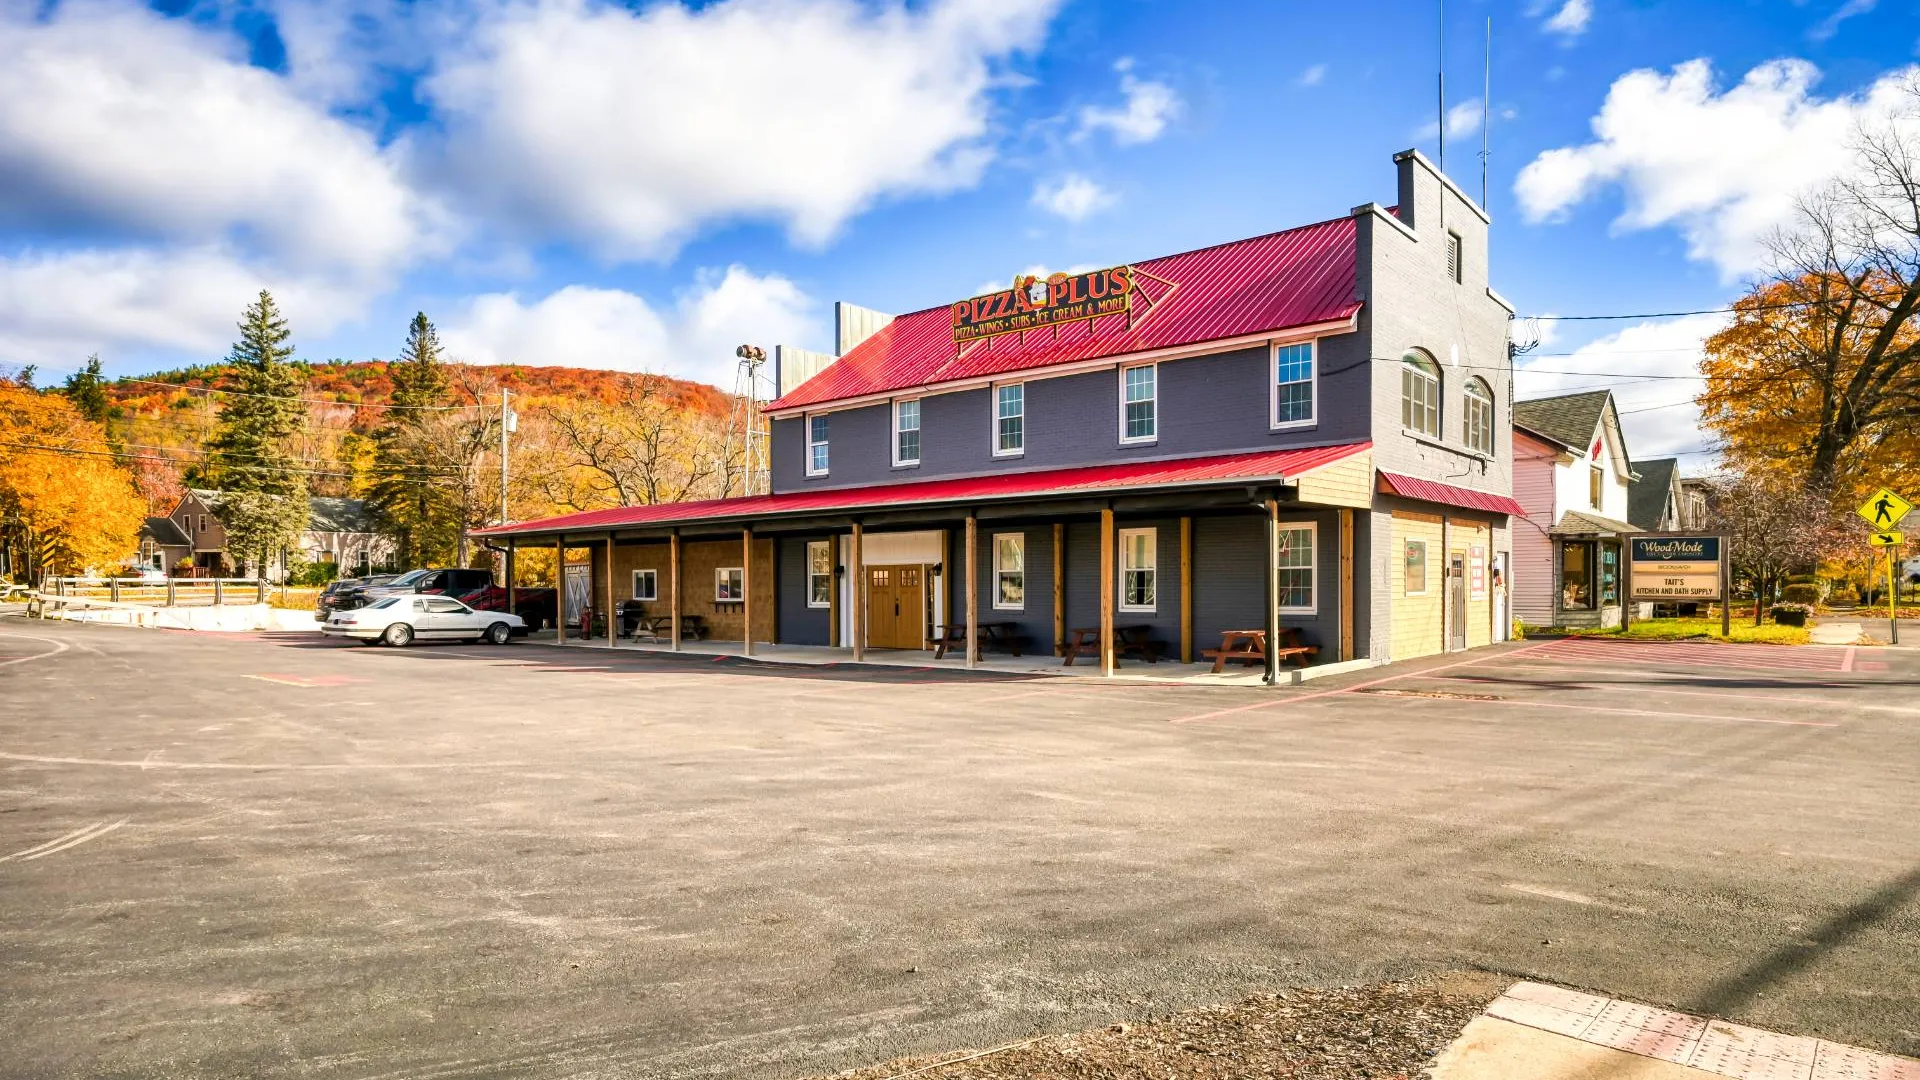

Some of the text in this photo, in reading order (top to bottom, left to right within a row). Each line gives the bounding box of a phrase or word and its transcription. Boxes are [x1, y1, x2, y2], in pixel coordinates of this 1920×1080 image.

[954, 266, 1129, 326] PIZZA PLUS
[955, 296, 1124, 339] PIZZA WINGS SUBS ICE CREAM & MORE
[1640, 541, 1703, 552] Wood-Mode
[1664, 578, 1685, 586] TAIT'S
[1636, 587, 1660, 595] KITCHEN
[1661, 587, 1673, 595] AND
